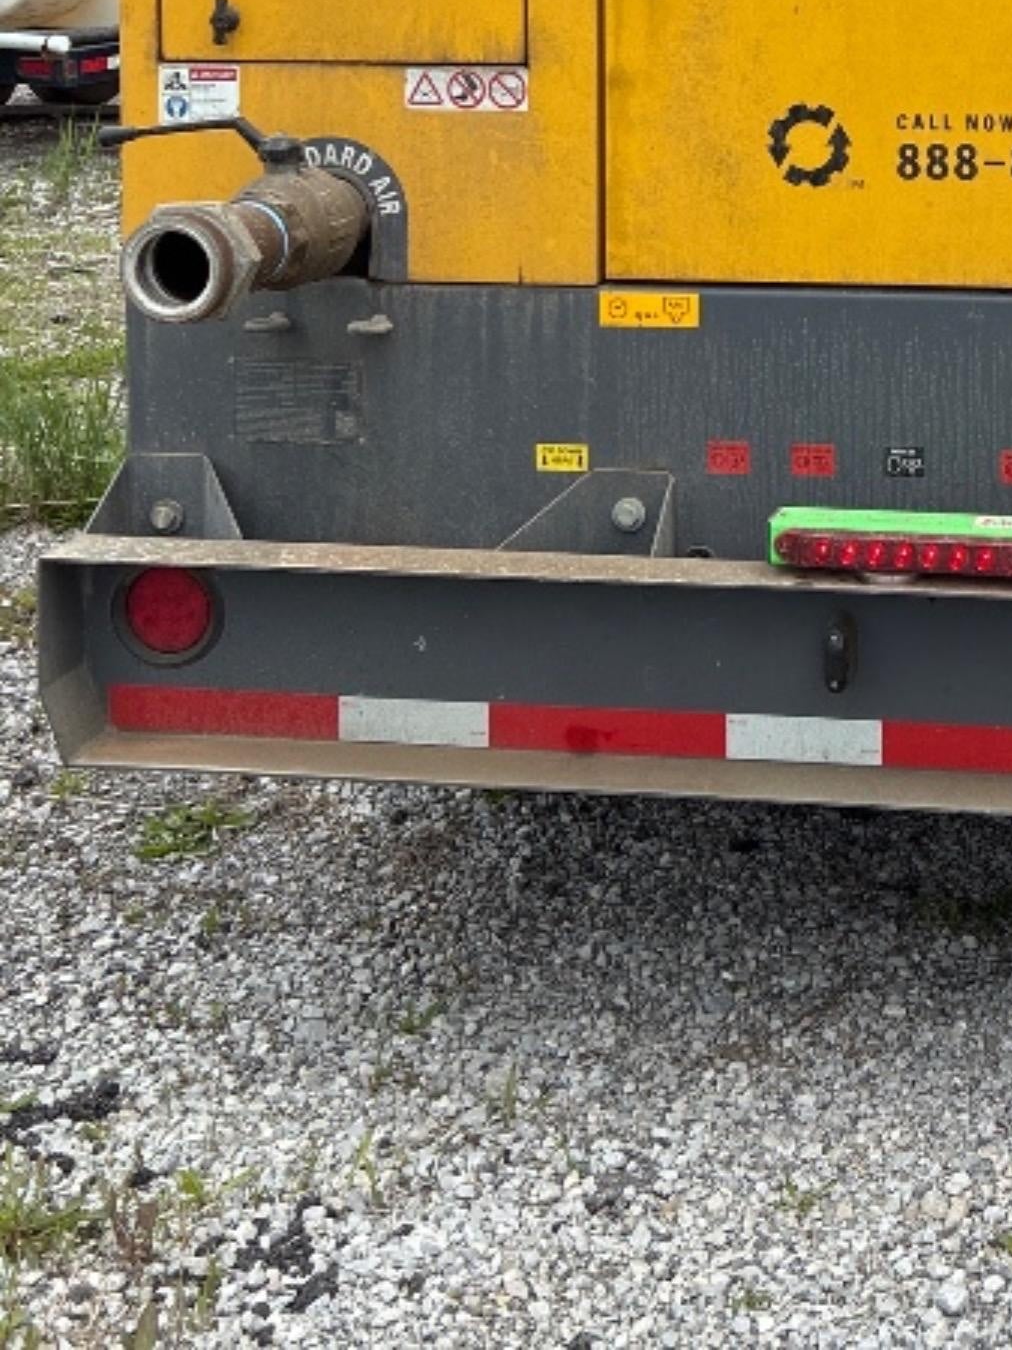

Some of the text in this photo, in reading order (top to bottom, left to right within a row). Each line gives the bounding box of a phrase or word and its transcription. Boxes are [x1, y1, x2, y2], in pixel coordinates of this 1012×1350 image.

[895, 113, 953, 132] CALL
[304, 143, 401, 216] DARD AIR
